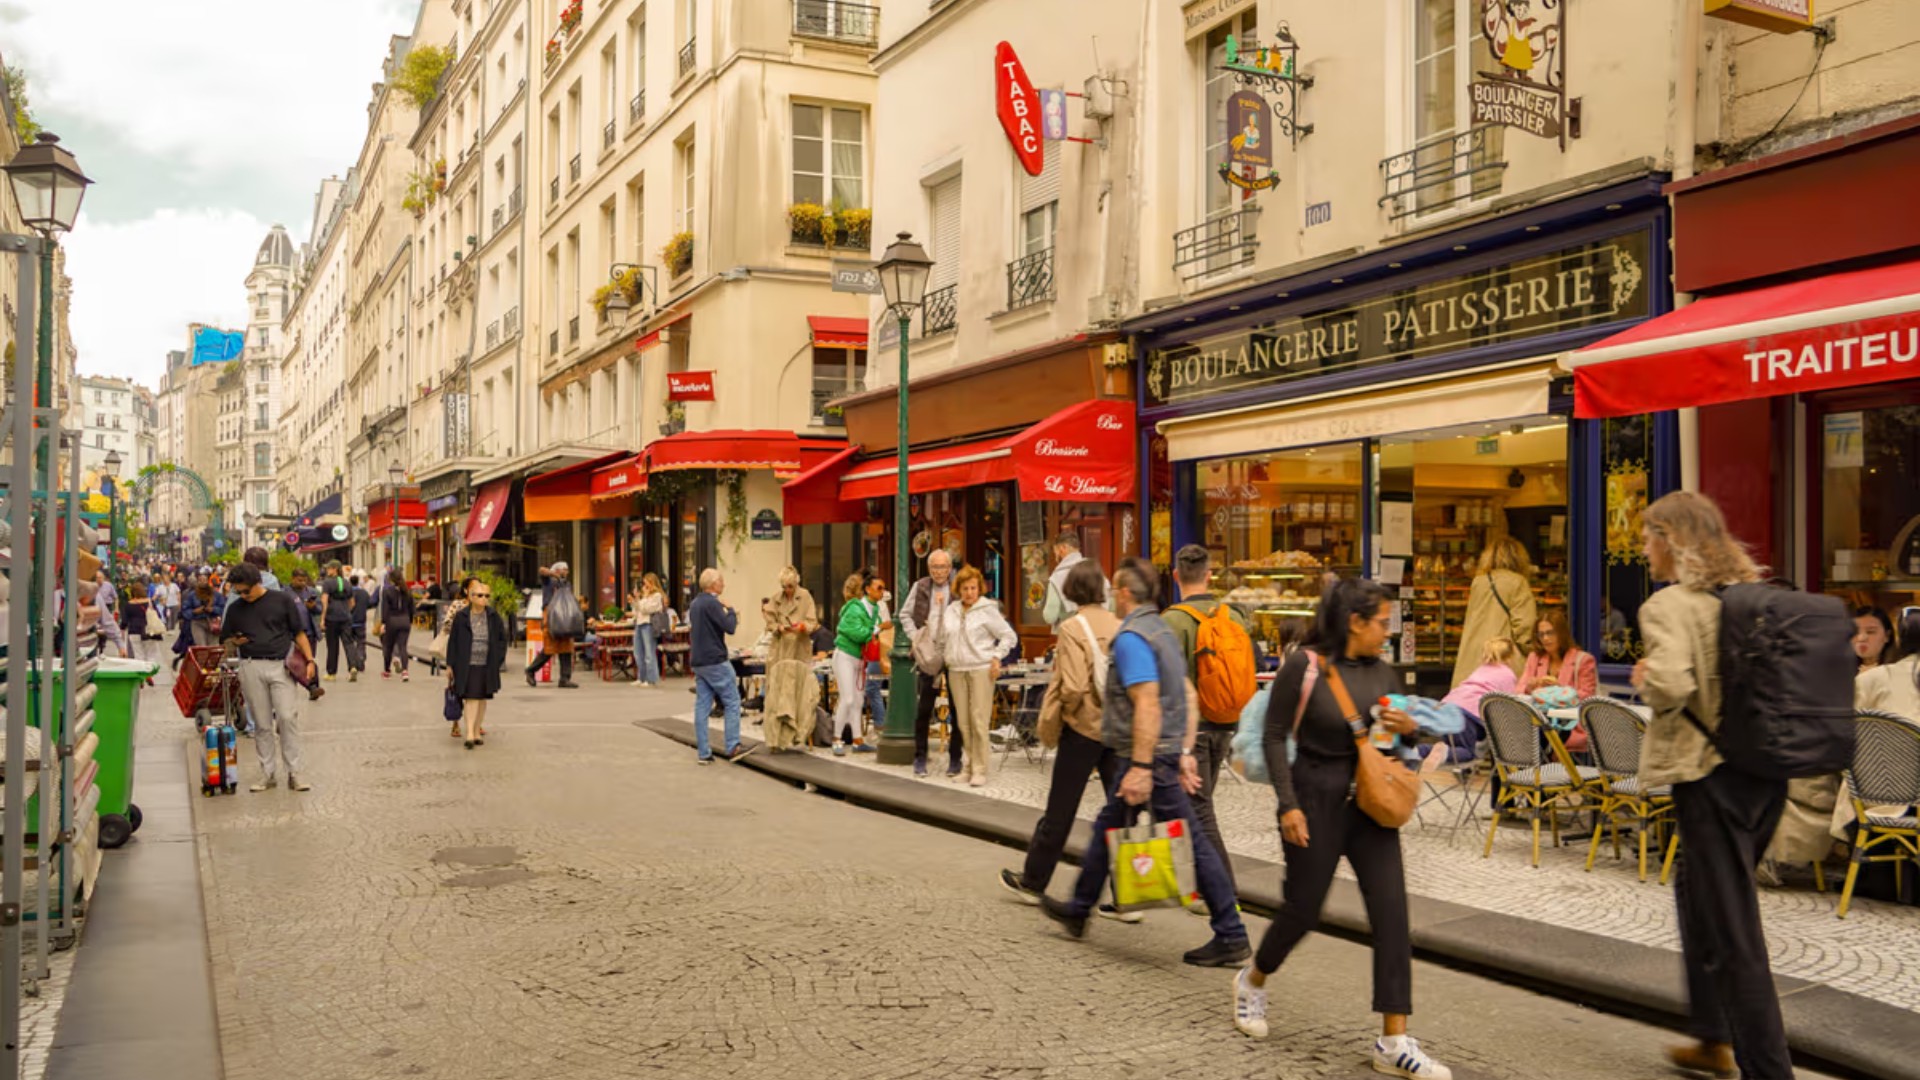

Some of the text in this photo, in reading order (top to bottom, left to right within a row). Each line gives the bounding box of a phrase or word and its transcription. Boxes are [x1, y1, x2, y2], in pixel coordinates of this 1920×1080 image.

[1002, 61, 1038, 153] TABAC
[1474, 83, 1553, 119] BOULANGER
[1477, 102, 1545, 135] PATISSIER
[1308, 204, 1329, 227] 100
[839, 271, 859, 284] FDJ
[1170, 266, 1595, 389] BOULANGERIE PATISSERIE
[1743, 327, 1919, 383] TRAITEU
[1096, 413, 1123, 430] Bar
[1034, 438, 1089, 456] Brasserie
[1044, 475, 1117, 495] Le Havane
